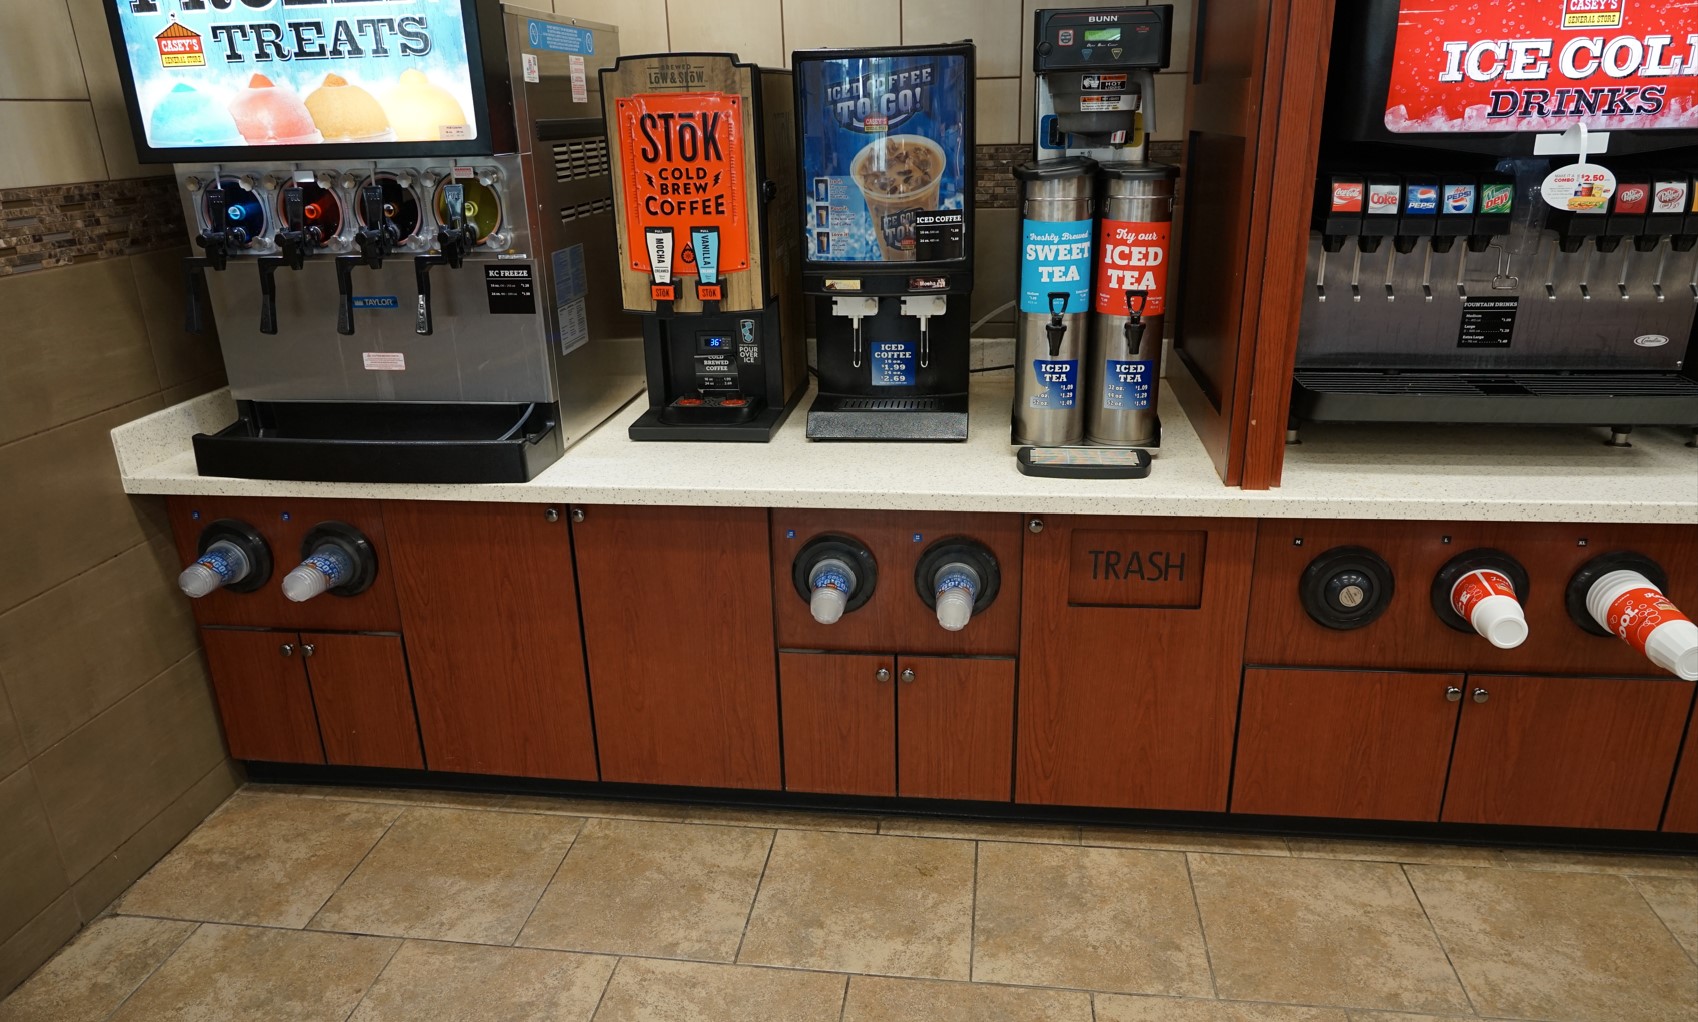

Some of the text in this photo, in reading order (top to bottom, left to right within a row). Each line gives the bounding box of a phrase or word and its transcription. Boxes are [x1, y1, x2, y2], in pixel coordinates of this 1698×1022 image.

[1088, 15, 1118, 23] BUNN
[1567, 14, 1617, 24] GENERAL STORE
[161, 39, 199, 52] CASEY'S
[209, 16, 431, 64] TREATS
[1438, 38, 1554, 83] ICE
[670, 72, 677, 84] &
[827, 68, 931, 102] ICED COFFEE
[836, 87, 922, 126] TO GO!
[1486, 85, 1668, 119] DRINKS
[658, 167, 708, 180] COLD
[1581, 173, 1605, 182] $2.50
[660, 182, 709, 195] BREW
[1371, 193, 1398, 205] Coke
[1447, 190, 1472, 201] PEPSI
[645, 194, 725, 216] COFFEE
[916, 214, 962, 224] ICED COFFEE
[1030, 230, 1089, 244] Freshly Brewed
[1116, 228, 1158, 244] Try our
[655, 238, 665, 264] MOCHA
[701, 235, 711, 266] VANILLA
[1026, 241, 1091, 261] SWEET
[1104, 244, 1163, 266] ICED
[1038, 265, 1080, 283] TEA
[1107, 269, 1157, 290] TEA
[364, 298, 393, 306] TAYLOR
[1041, 364, 1071, 373] ICED
[1115, 364, 1145, 373] ICED
[1044, 374, 1067, 382] TEA
[1118, 374, 1142, 383] TEA
[1088, 550, 1186, 582] TRASH
